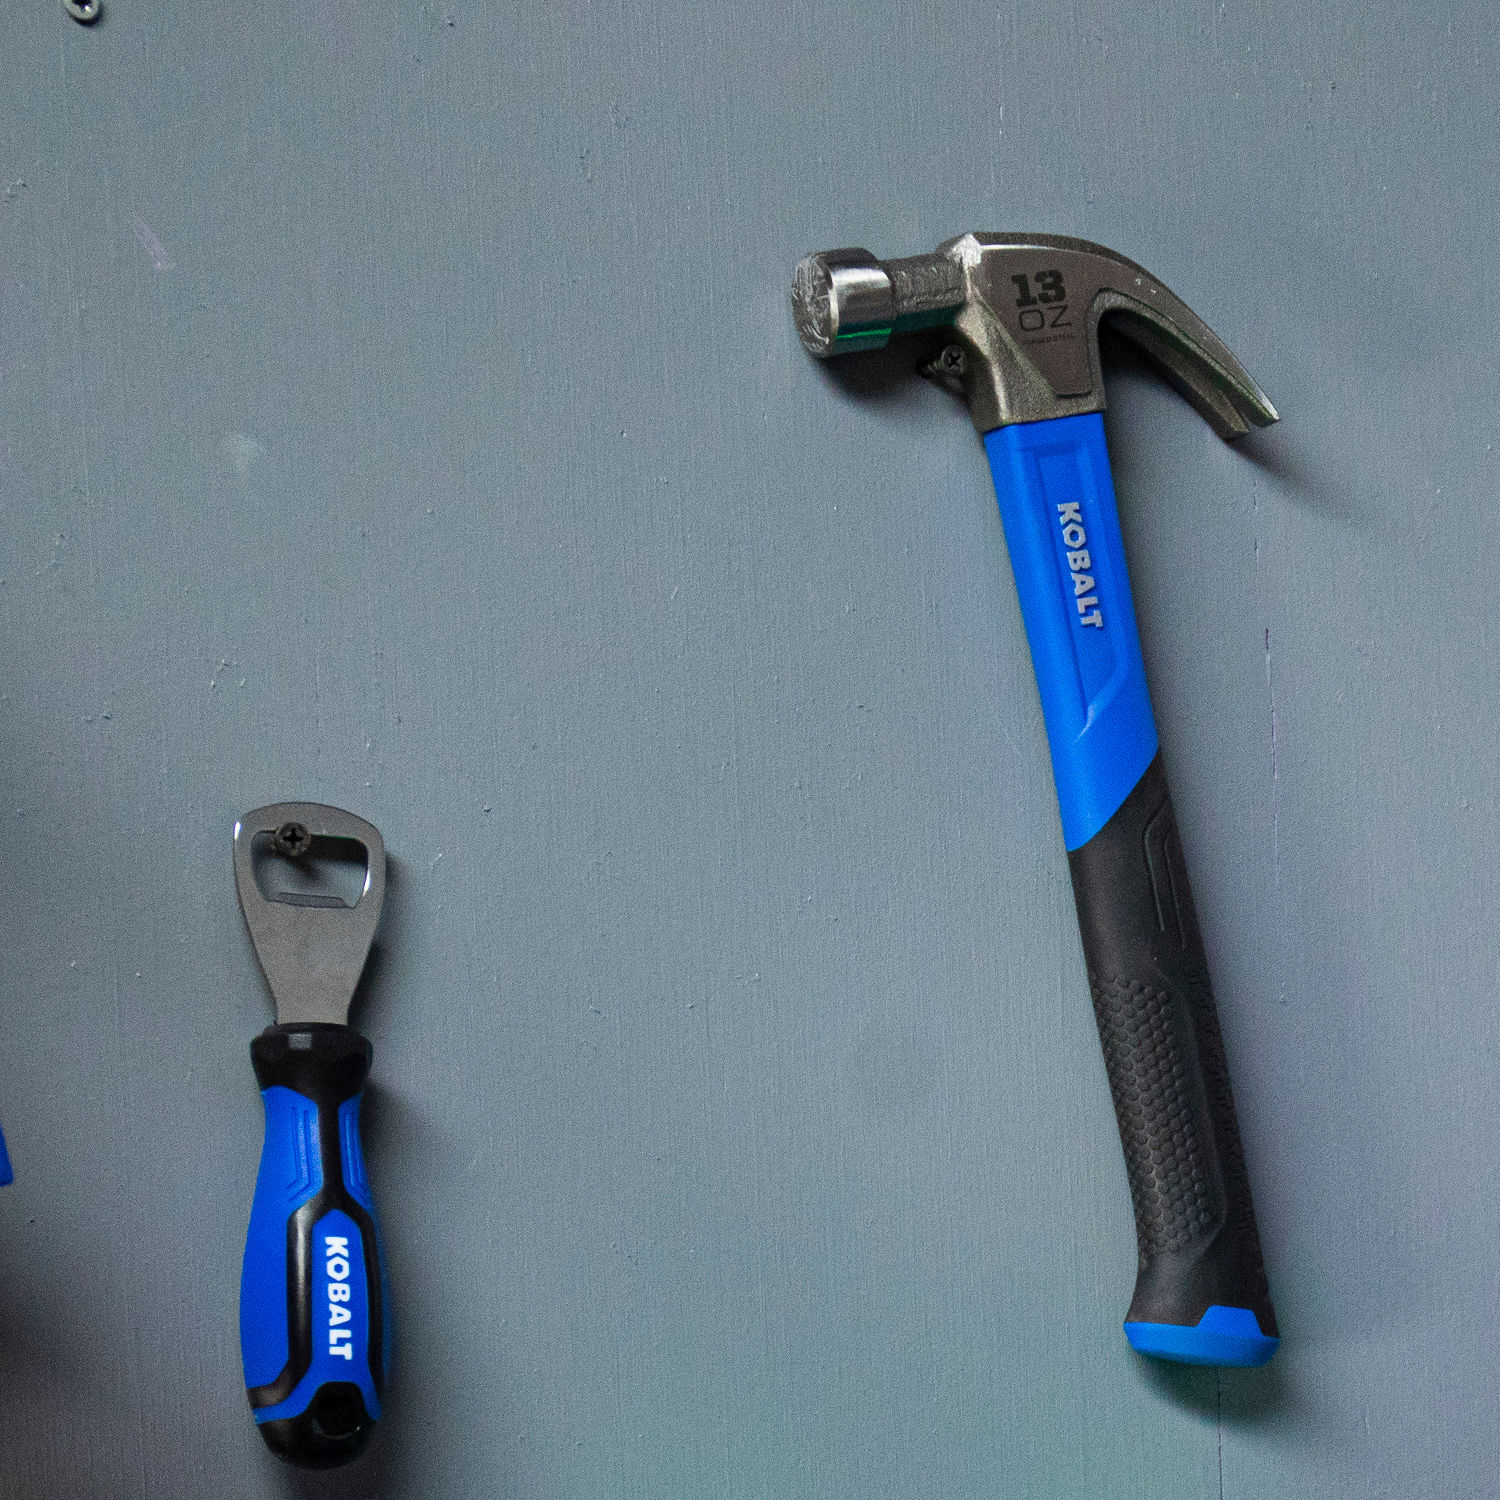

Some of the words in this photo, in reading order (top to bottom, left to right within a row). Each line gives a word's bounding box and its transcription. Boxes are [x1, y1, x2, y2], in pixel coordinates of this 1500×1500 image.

[1011, 269, 1066, 307] 13
[1019, 304, 1072, 332] OZ
[1057, 501, 1104, 628] KOBALT
[325, 1236, 353, 1361] KOBALT
